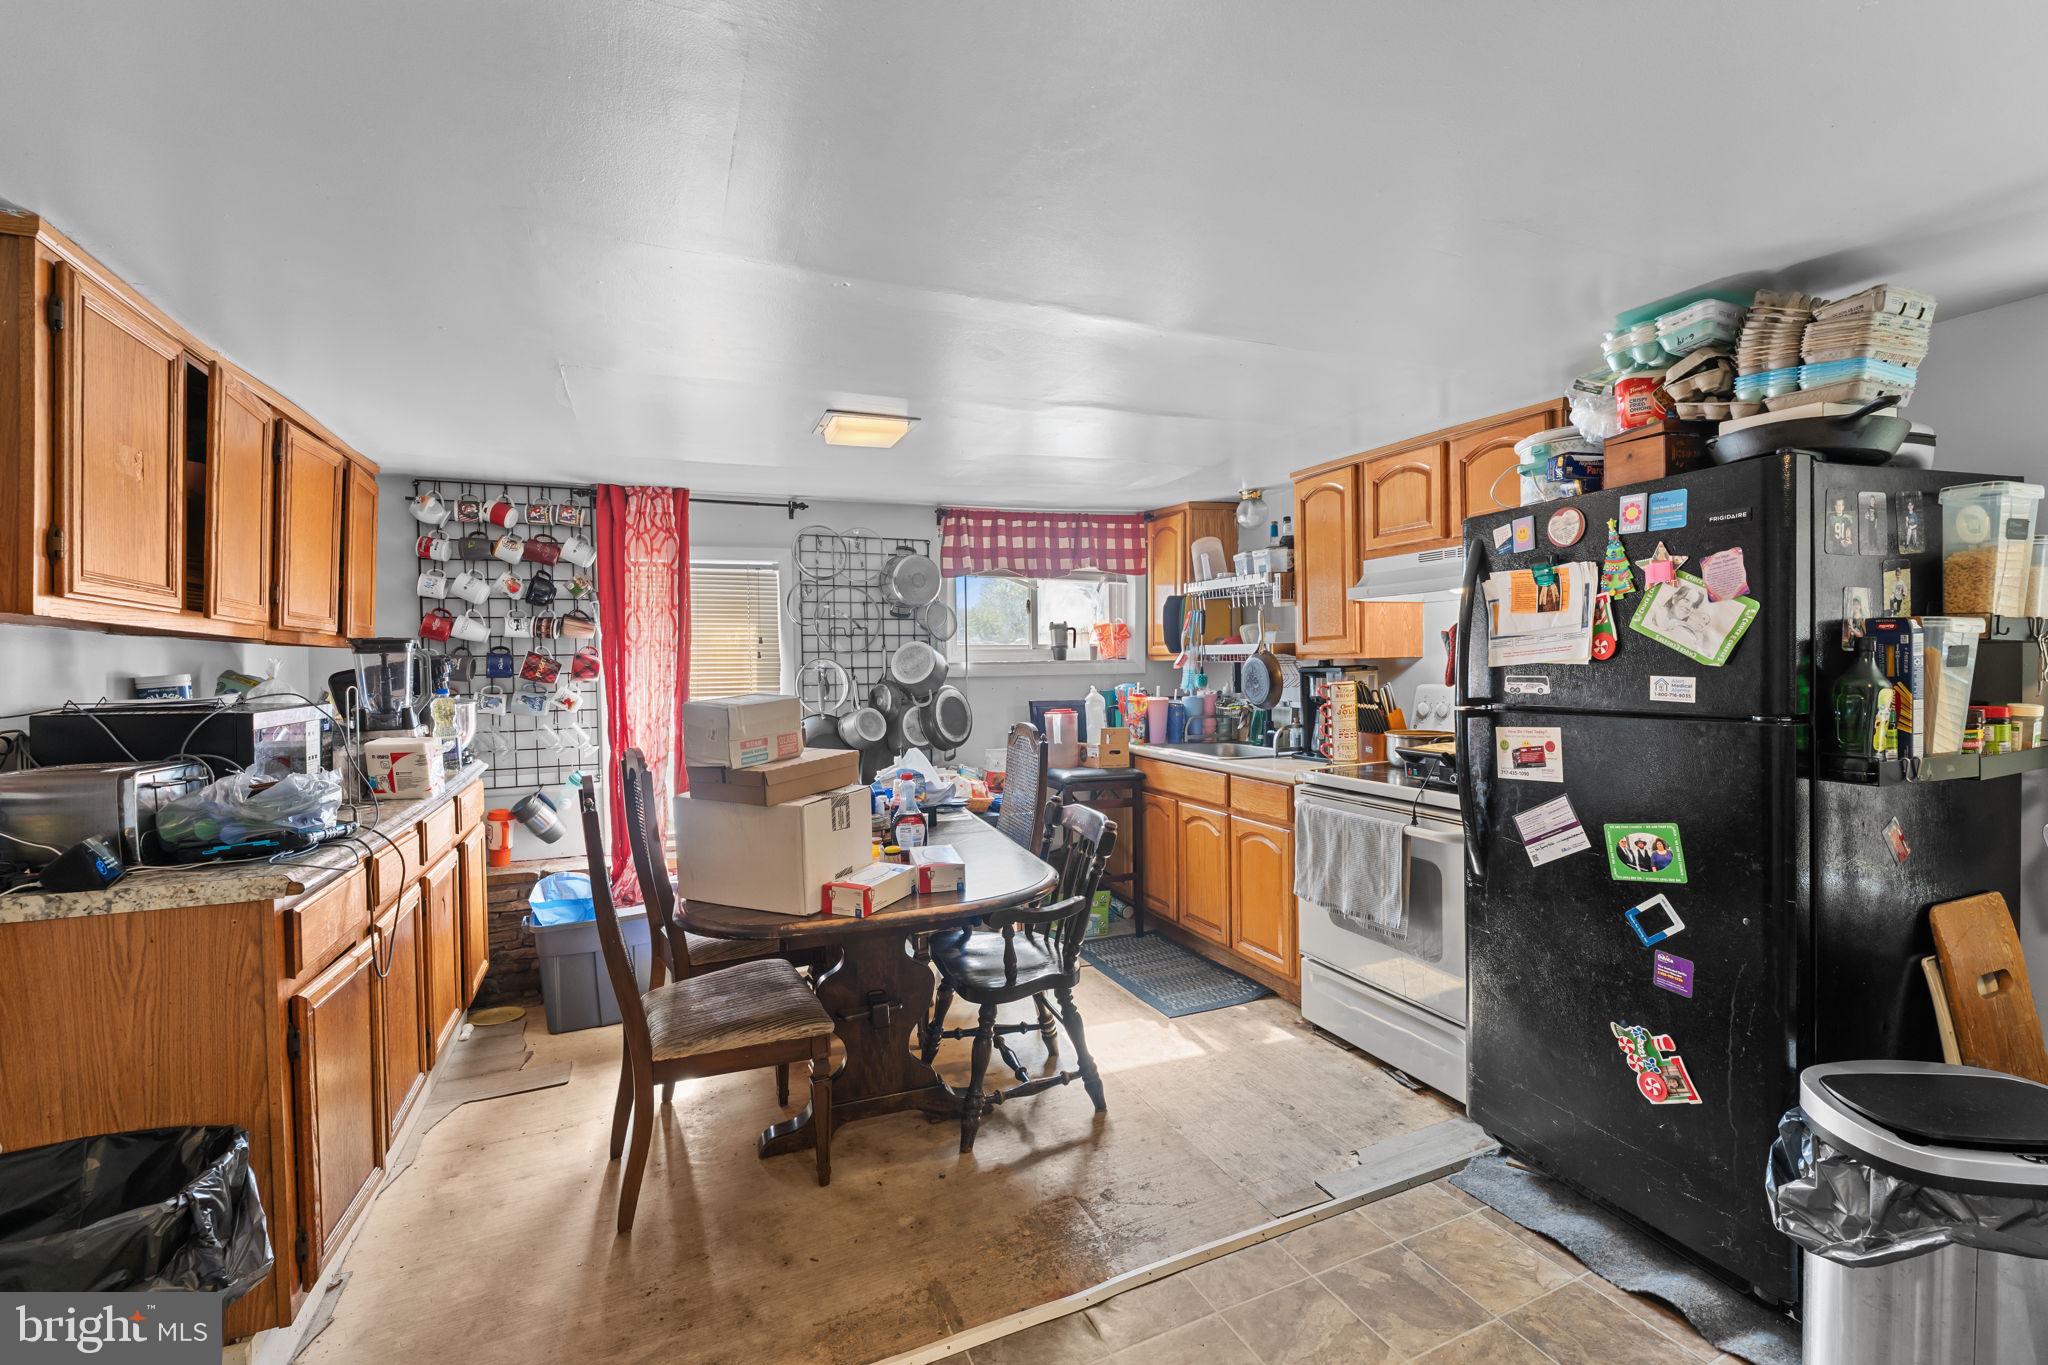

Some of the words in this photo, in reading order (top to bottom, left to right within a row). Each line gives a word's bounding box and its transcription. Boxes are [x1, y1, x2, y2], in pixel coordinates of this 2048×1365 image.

[1629, 396, 1648, 404] CRISPY
[1709, 511, 1747, 522] FRIGIDAIRE
[1835, 522, 1845, 539] 91
